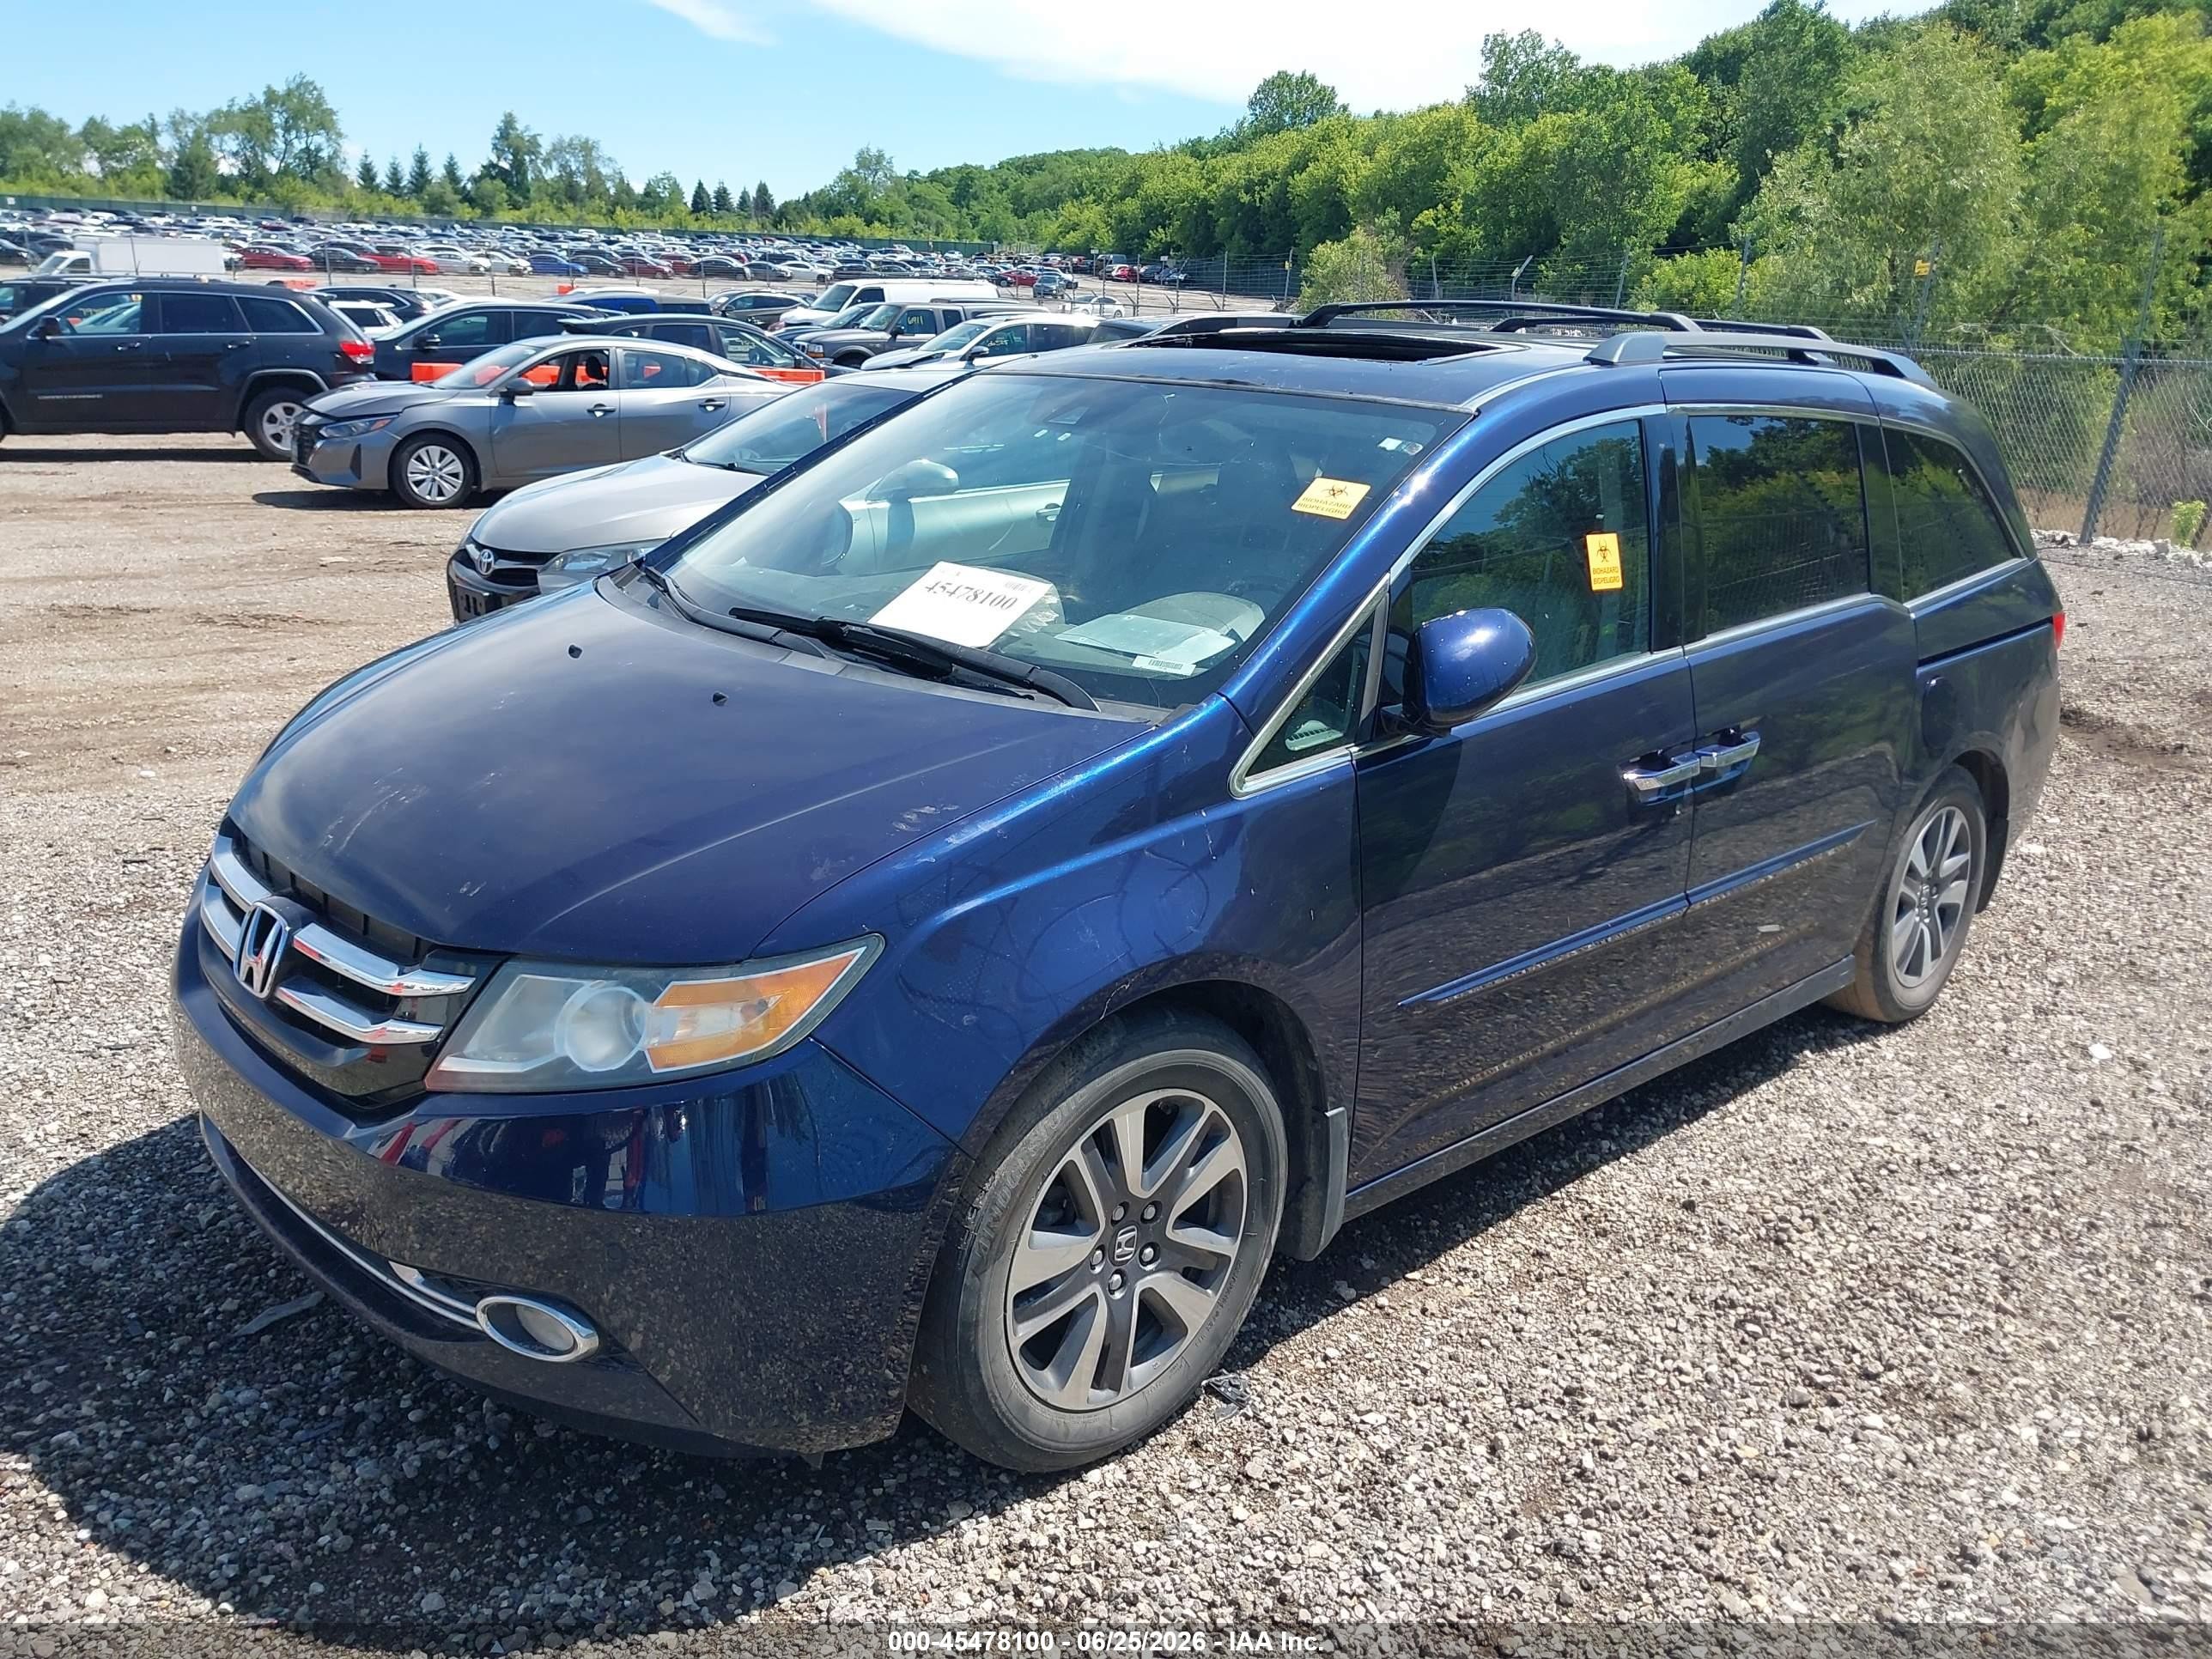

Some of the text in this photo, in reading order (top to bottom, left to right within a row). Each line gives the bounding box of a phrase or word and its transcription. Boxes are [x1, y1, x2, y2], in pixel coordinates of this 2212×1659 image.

[1297, 502, 1347, 516] BIOPELIGRO
[1302, 496, 1352, 509] BIOHAZARD
[1592, 566, 1620, 574] BIOHAZARD
[1593, 576, 1620, 585] BIOPELIGRO
[926, 580, 1018, 610] 45478100
